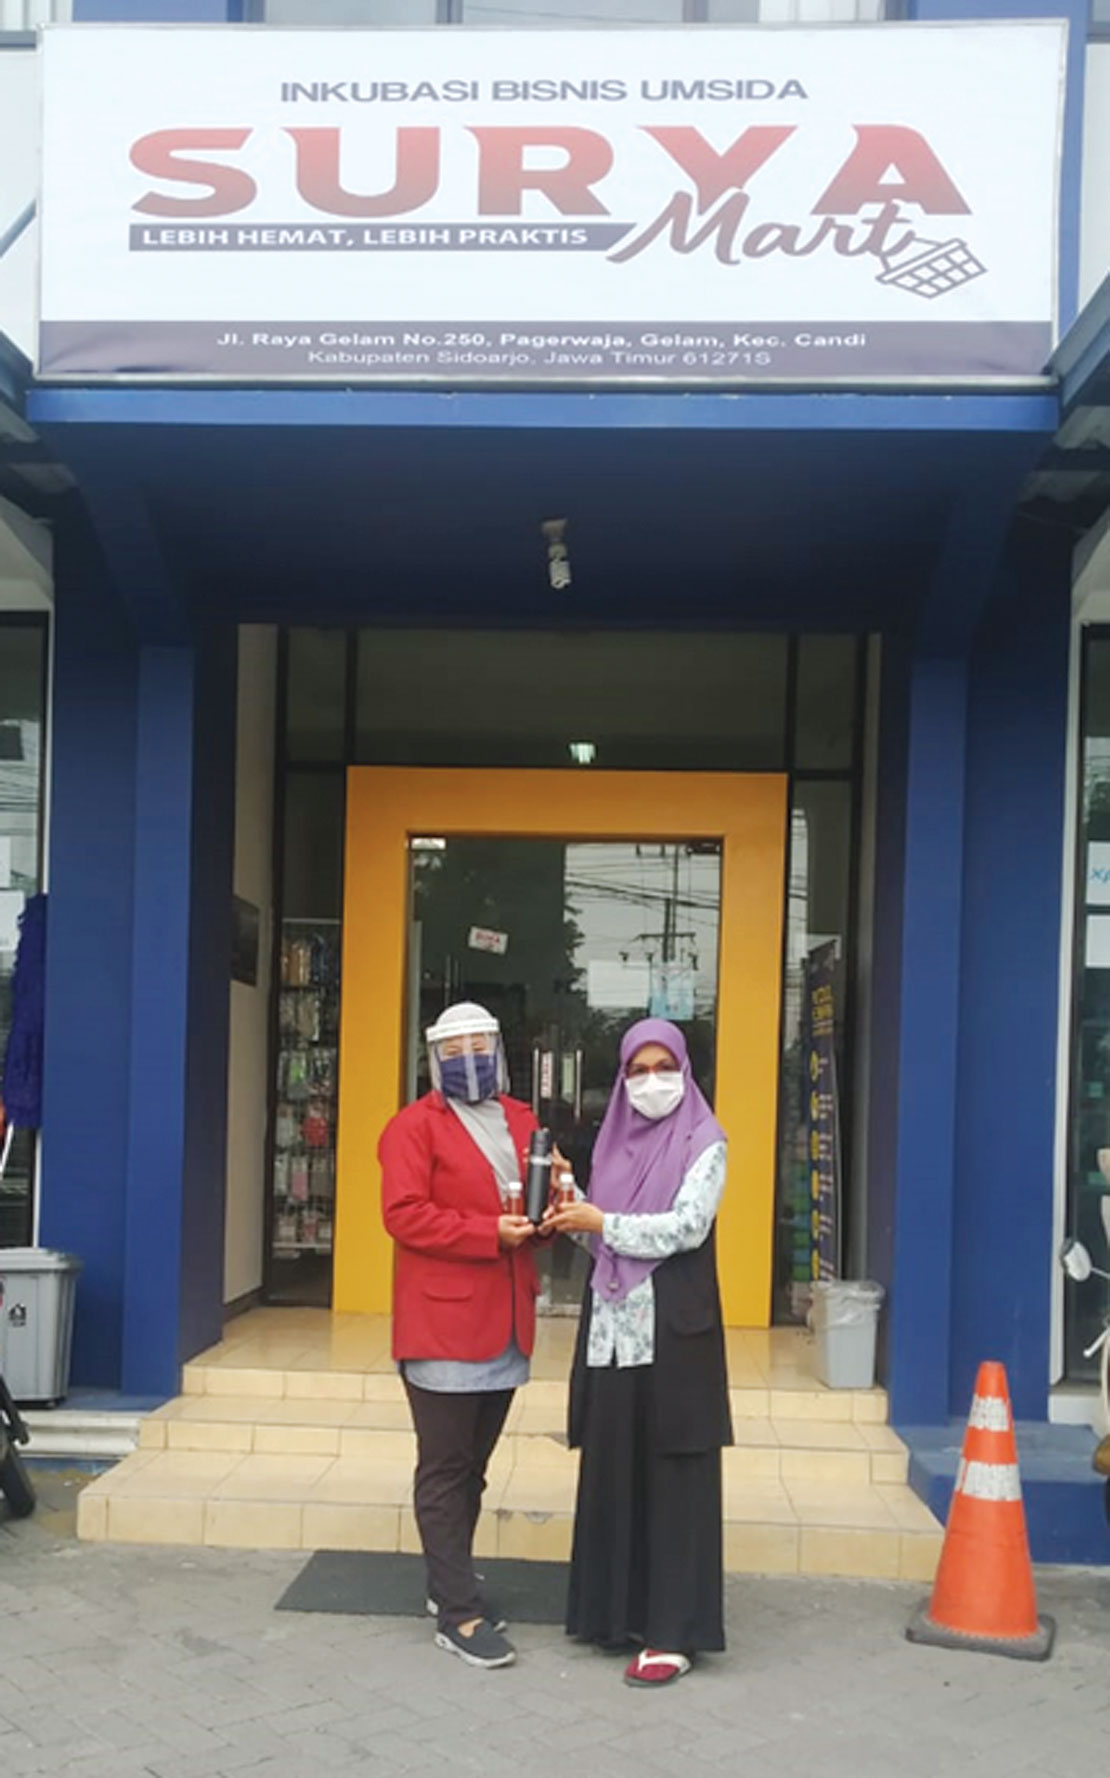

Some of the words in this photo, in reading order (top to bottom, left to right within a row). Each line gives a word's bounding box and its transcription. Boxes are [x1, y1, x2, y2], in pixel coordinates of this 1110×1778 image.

[280, 80, 480, 103] INKUBASI
[491, 80, 627, 101] BISNIS
[641, 79, 808, 101] UMSIDA
[129, 125, 972, 218] SURYA
[143, 229, 229, 245] LEBIH
[237, 229, 355, 247] HEMAT,
[364, 229, 450, 245] LEBIH
[459, 228, 588, 244] PRAKTIS
[606, 190, 916, 265] Mart
[252, 333, 312, 349] Raya
[319, 333, 395, 346] Gelam
[500, 333, 632, 349] Pagerwaja,
[733, 333, 786, 347] Kec.
[794, 333, 866, 347] Candi
[307, 351, 430, 365] Kabupaten
[544, 351, 603, 365] Jawa
[611, 351, 676, 365] Timur
